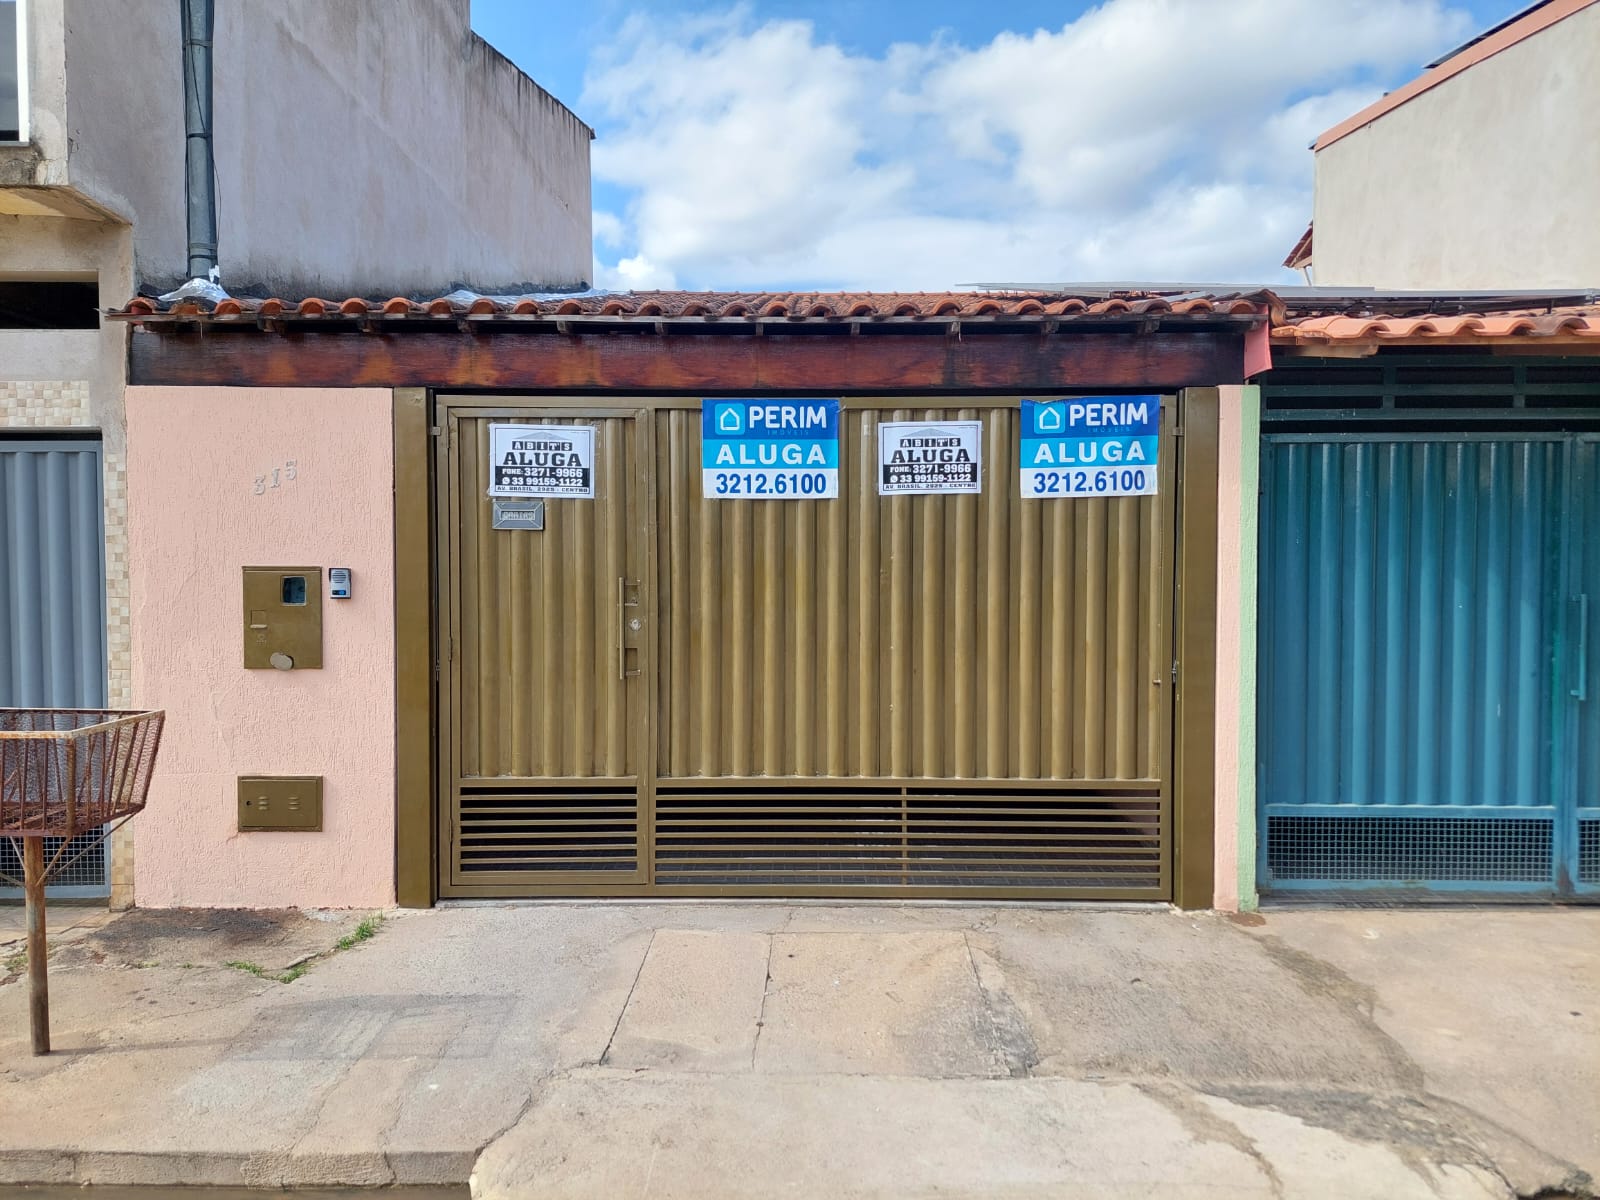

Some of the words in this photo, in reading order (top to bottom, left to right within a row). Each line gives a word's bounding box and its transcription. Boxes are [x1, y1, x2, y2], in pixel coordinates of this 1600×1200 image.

[749, 406, 827, 429] PERIM
[1069, 402, 1148, 427] PERIM
[503, 452, 582, 466] ALUGA
[715, 443, 827, 465] ALUGA
[891, 449, 970, 463] ALUGA
[1033, 440, 1146, 464] ALUGA
[524, 467, 583, 477] 3271-9966
[912, 464, 972, 473] 3271-9966
[511, 477, 524, 486] 33
[525, 477, 583, 487] 99159-1122
[715, 473, 827, 494] 3212.6100
[899, 474, 912, 483] 33
[914, 473, 972, 483] 99159-1122
[1033, 469, 1146, 494] 3212.6100
